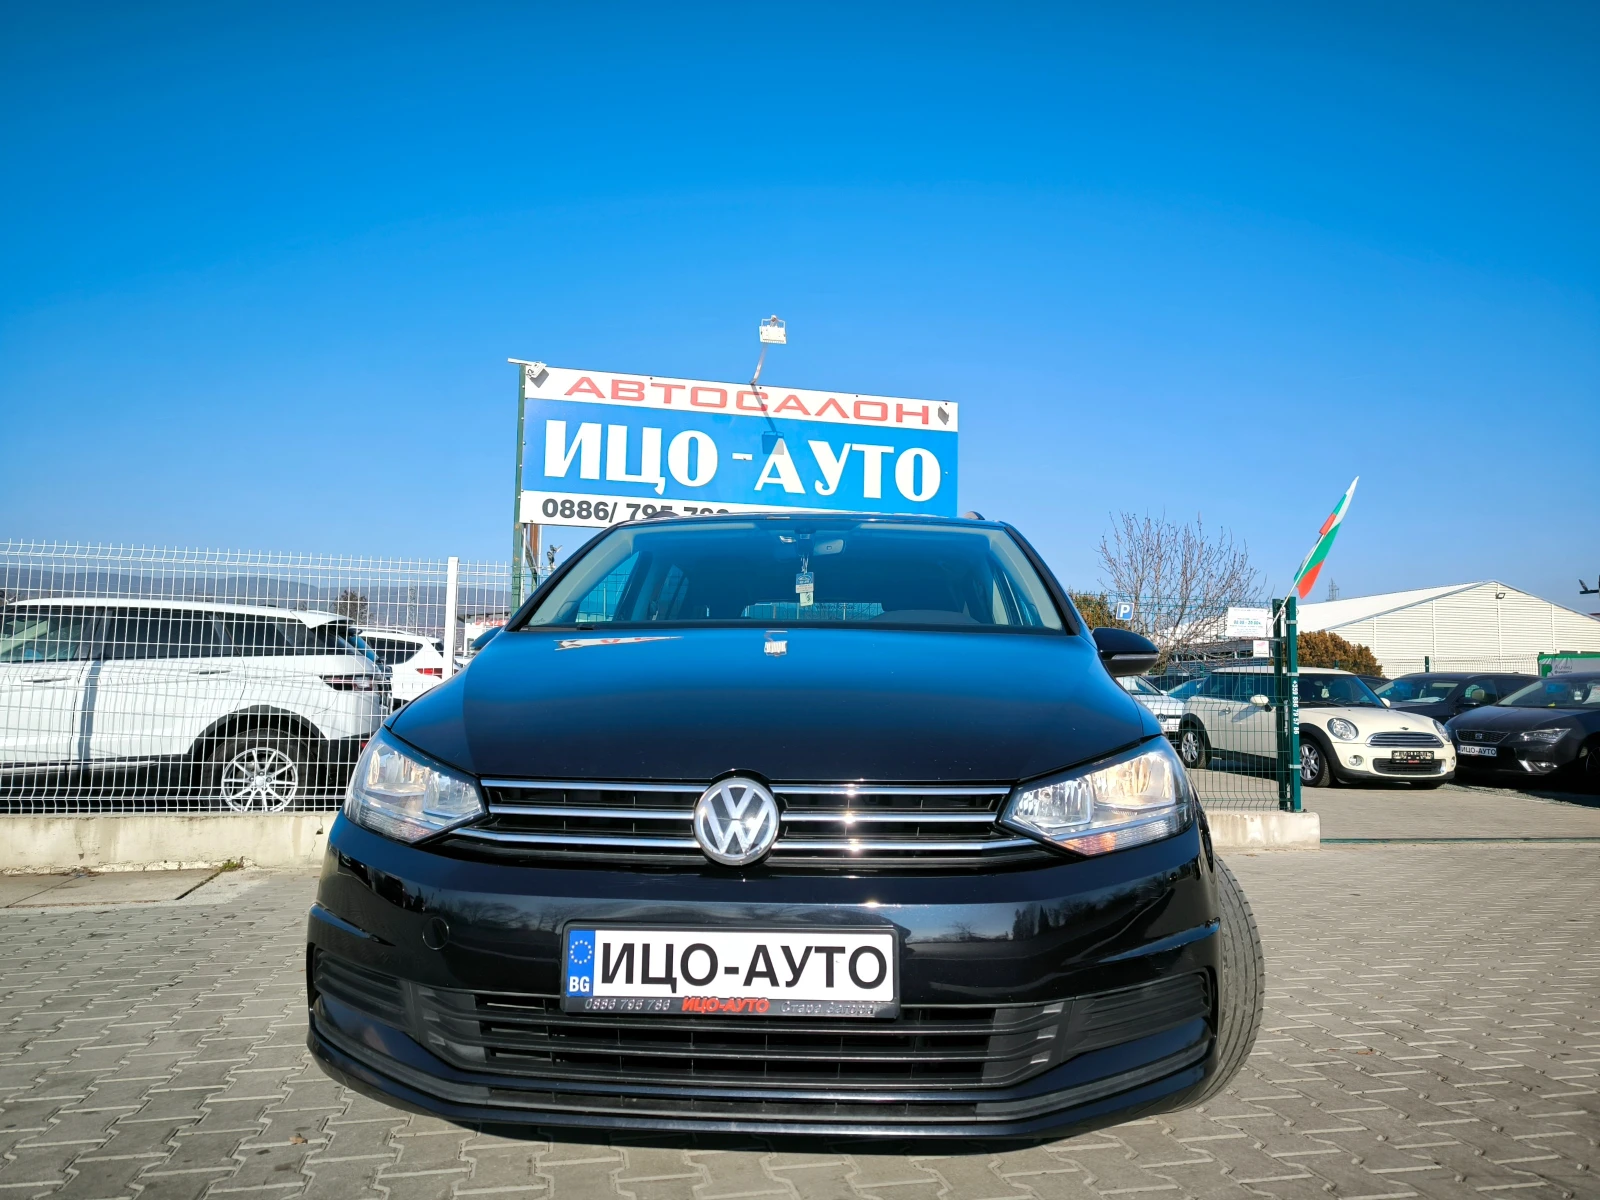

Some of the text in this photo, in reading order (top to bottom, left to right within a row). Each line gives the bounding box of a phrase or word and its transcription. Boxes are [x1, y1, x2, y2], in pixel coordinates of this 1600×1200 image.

[564, 376, 929, 425] АВТОСАЛОН
[542, 498, 618, 523] 0886/
[626, 503, 673, 520] 79
[1119, 604, 1130, 618] P
[601, 942, 888, 994] ИЦО-АУТО
[568, 975, 590, 993] BG
[681, 995, 771, 1014] ИЦО-АУТО
